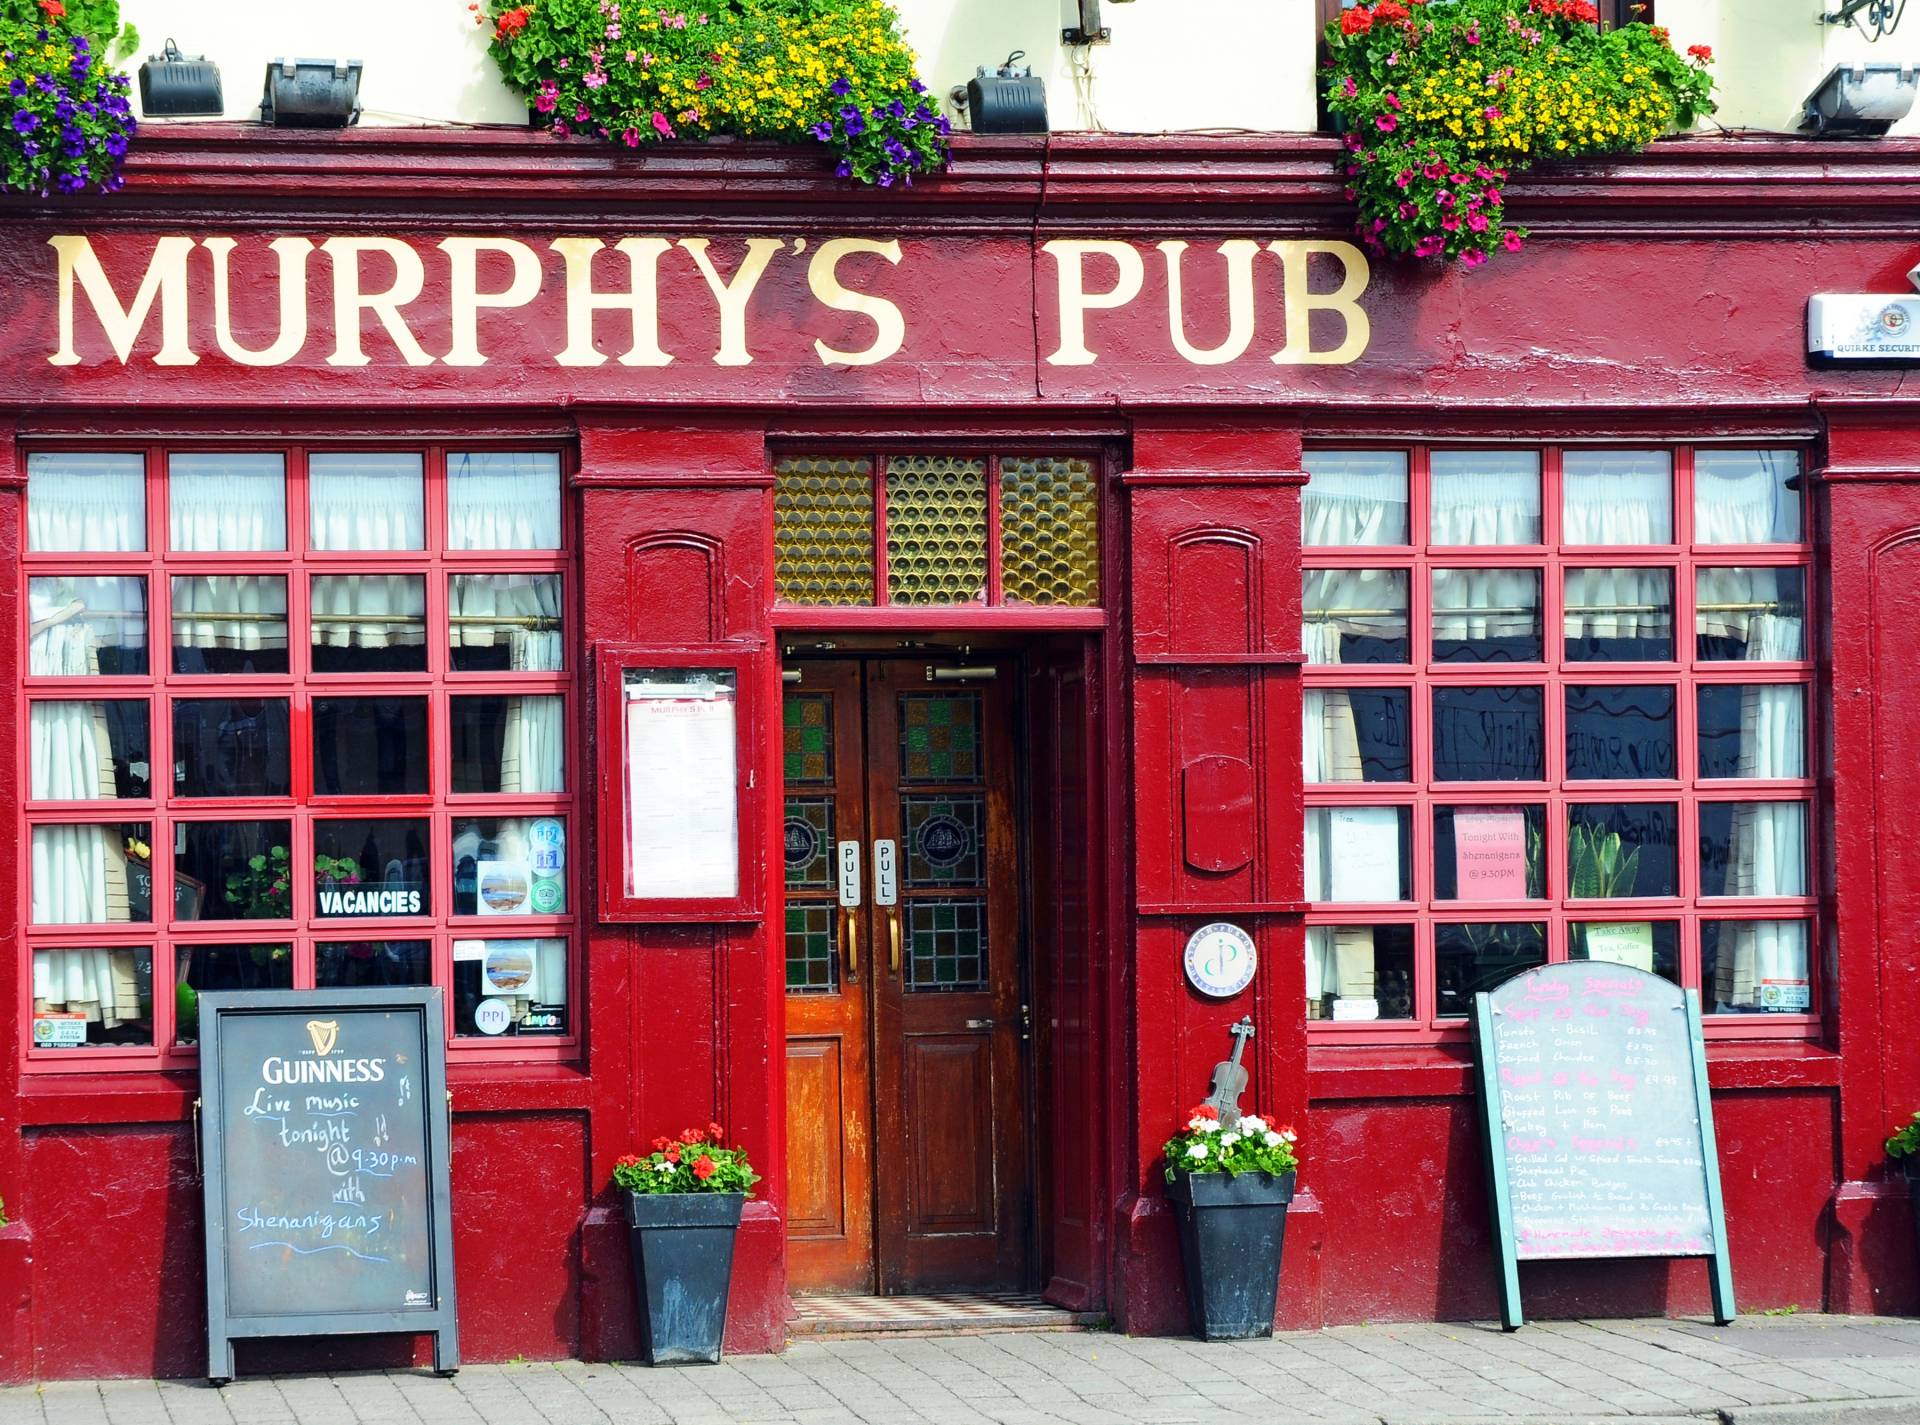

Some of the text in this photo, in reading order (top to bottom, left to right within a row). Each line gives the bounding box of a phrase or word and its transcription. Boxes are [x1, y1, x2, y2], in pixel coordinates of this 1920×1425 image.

[46, 234, 1372, 368] MURPHY'S PUB
[1463, 832, 1519, 843] Tonight With
[1462, 850, 1521, 862] Shenanigans
[844, 848, 855, 899] PULL
[880, 847, 890, 898] PULL
[319, 890, 421, 914] VACANCIES
[482, 1010, 504, 1022] PPI
[262, 1057, 386, 1085] GUINNESS
[243, 1087, 360, 1115] Live music
[1502, 1090, 1541, 1103] Roast
[1553, 1089, 1573, 1101] Rib
[279, 1116, 351, 1152] tonight
[326, 1142, 350, 1176] @
[332, 1176, 366, 1202] with
[236, 1207, 382, 1239] Shenanigans
